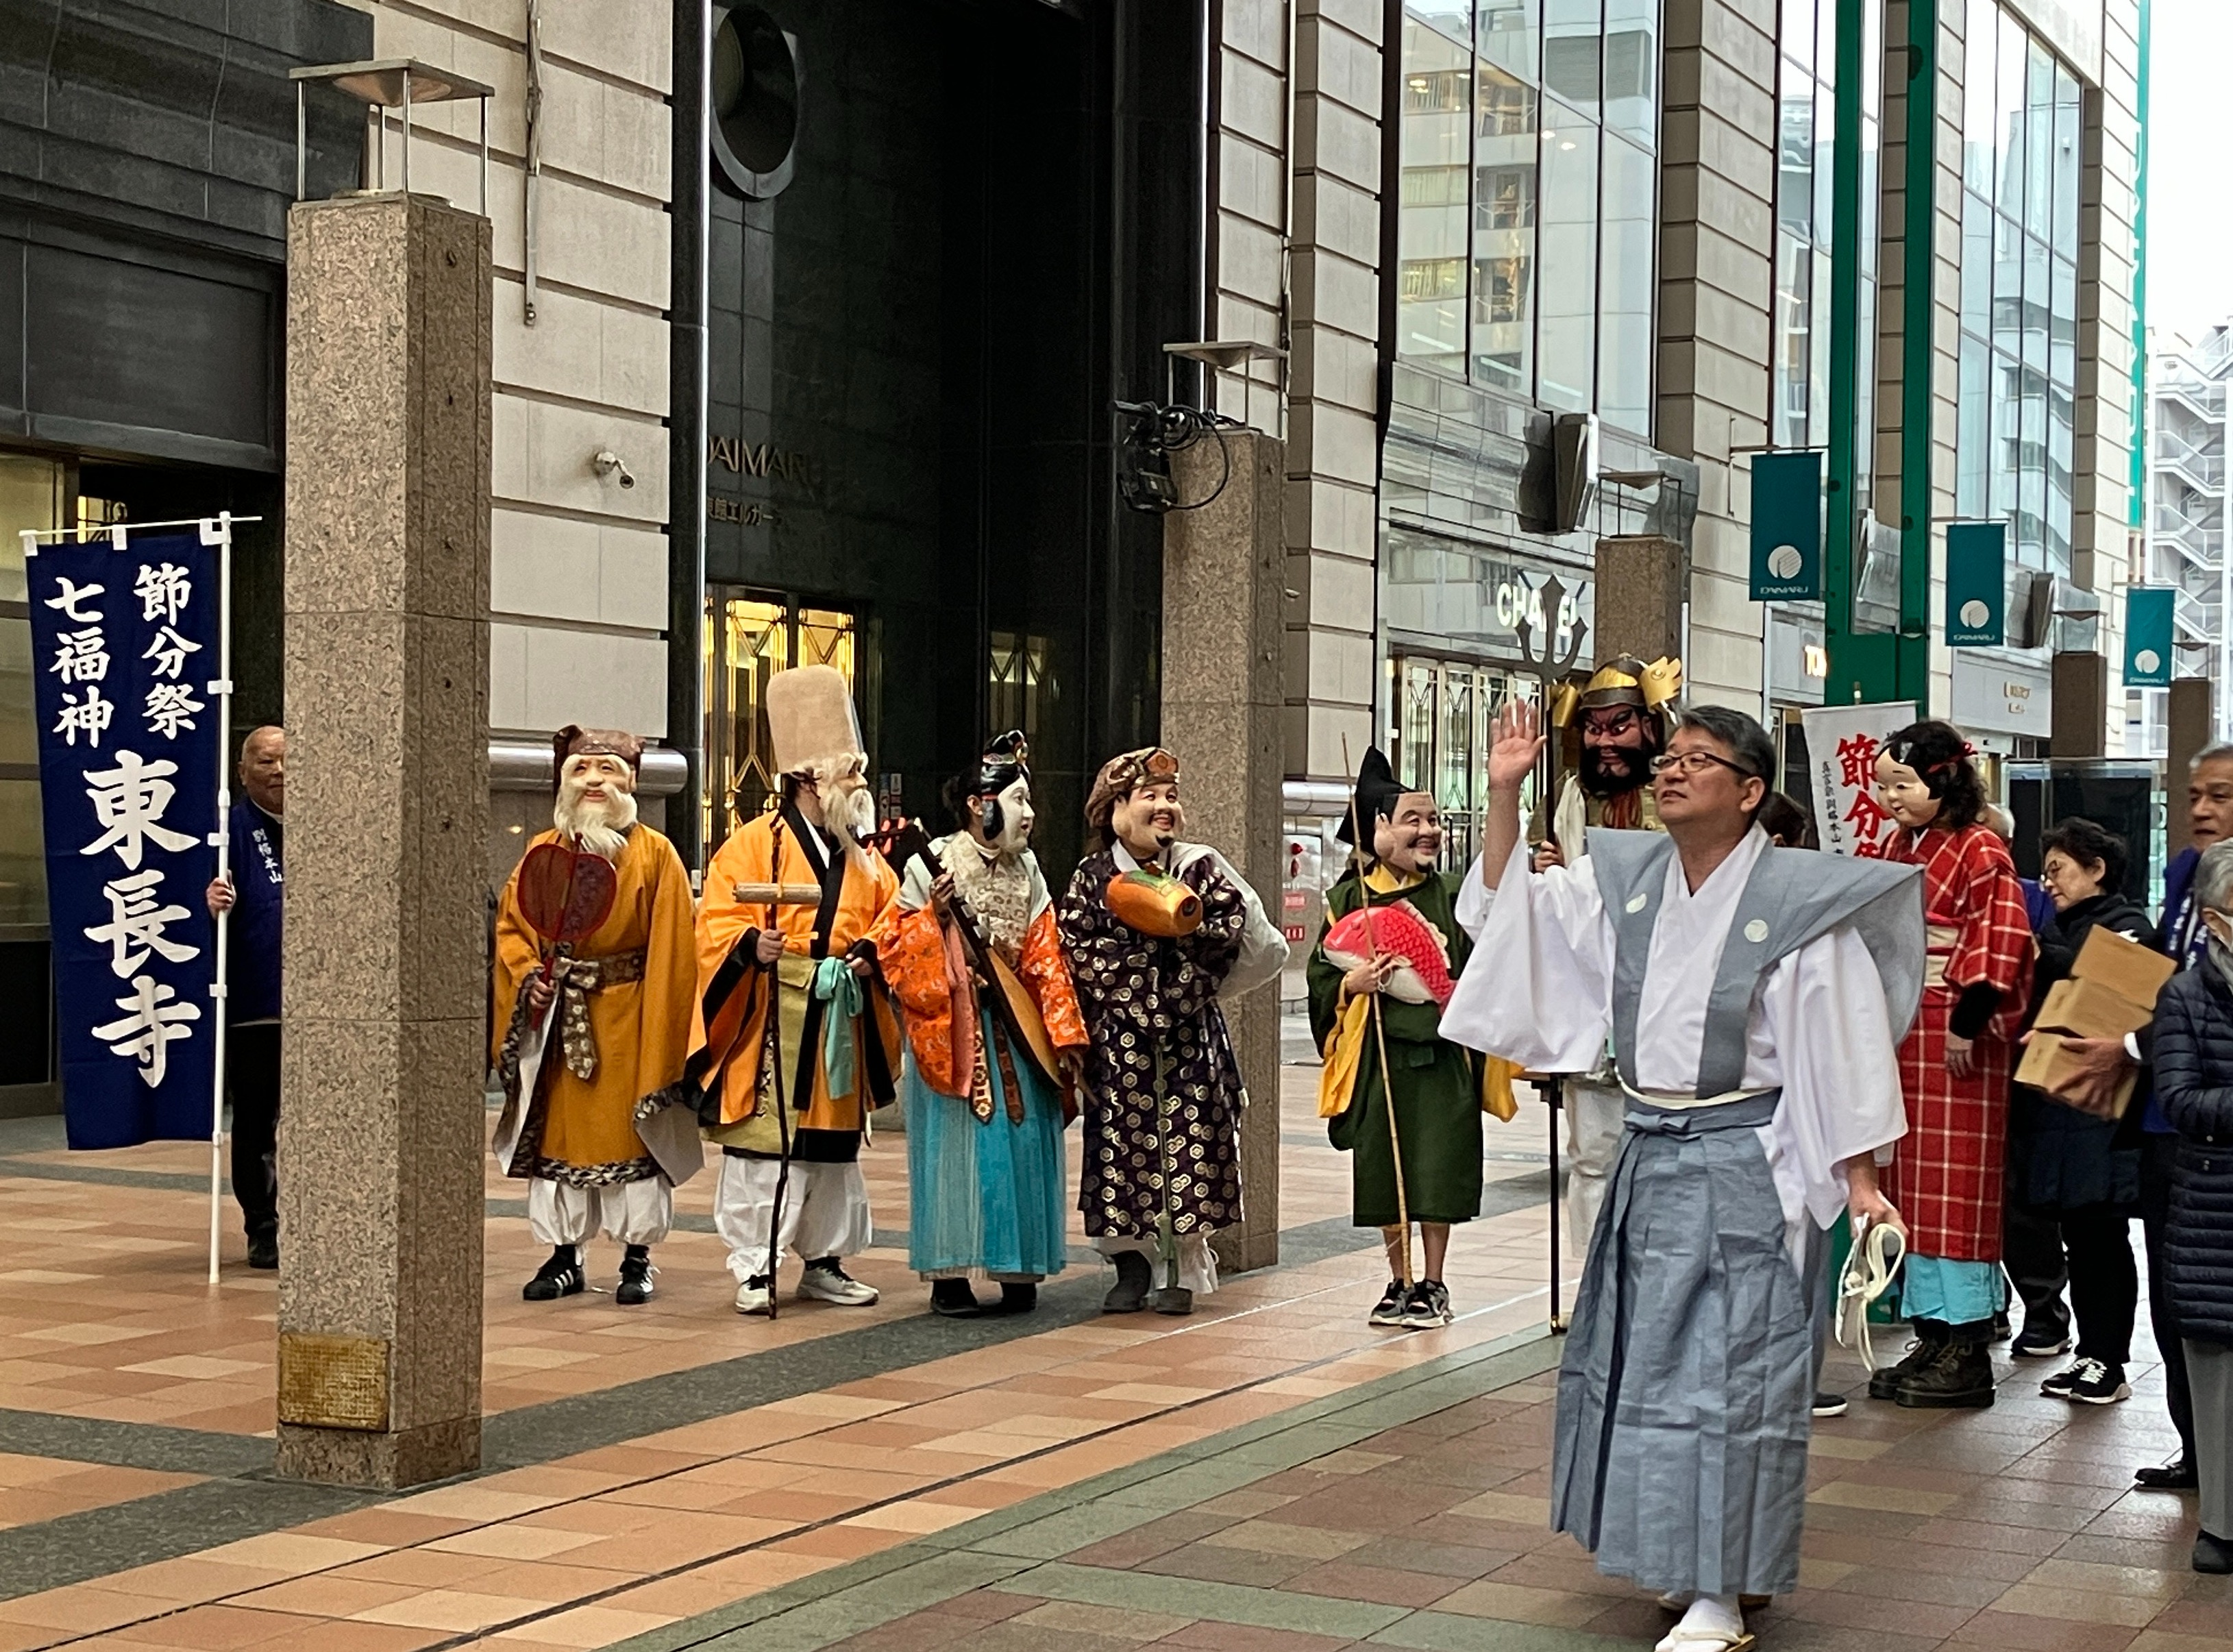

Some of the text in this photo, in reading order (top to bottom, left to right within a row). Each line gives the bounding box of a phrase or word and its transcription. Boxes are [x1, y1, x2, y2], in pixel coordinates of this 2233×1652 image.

[44, 577, 114, 748] 七福神
[133, 562, 205, 741] 節分祭
[1496, 582, 1578, 637] CHAEL
[79, 749, 201, 1088] 東長寺
